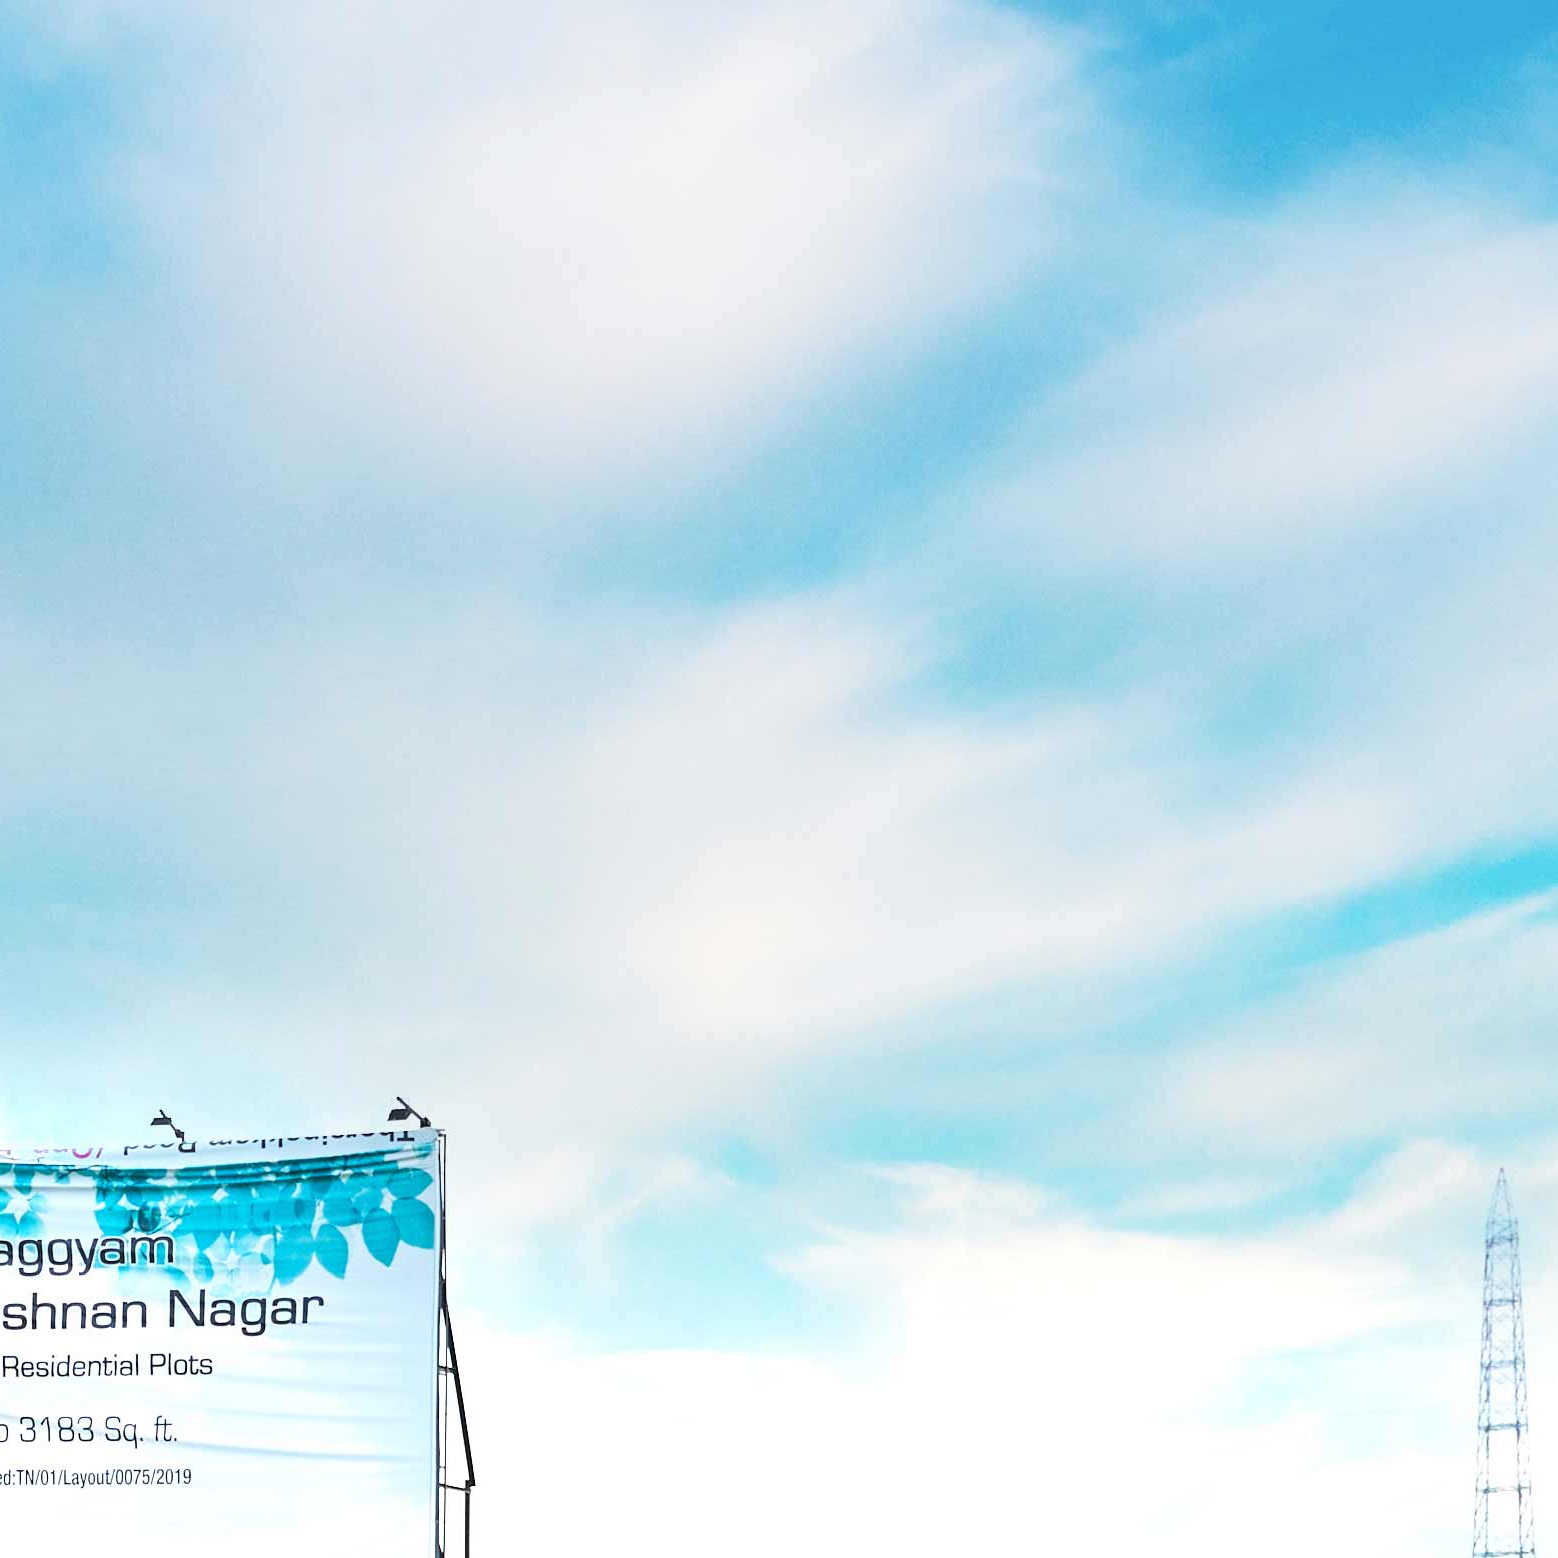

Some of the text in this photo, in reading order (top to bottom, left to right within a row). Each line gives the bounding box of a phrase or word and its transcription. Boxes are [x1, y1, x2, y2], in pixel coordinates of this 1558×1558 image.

[168, 1289, 325, 1337] Nagar
[2, 1353, 139, 1378] Residential
[150, 1353, 213, 1376] Plots
[19, 1416, 95, 1443] 3183
[104, 1416, 146, 1450] Sq.
[154, 1415, 178, 1442] ft.
